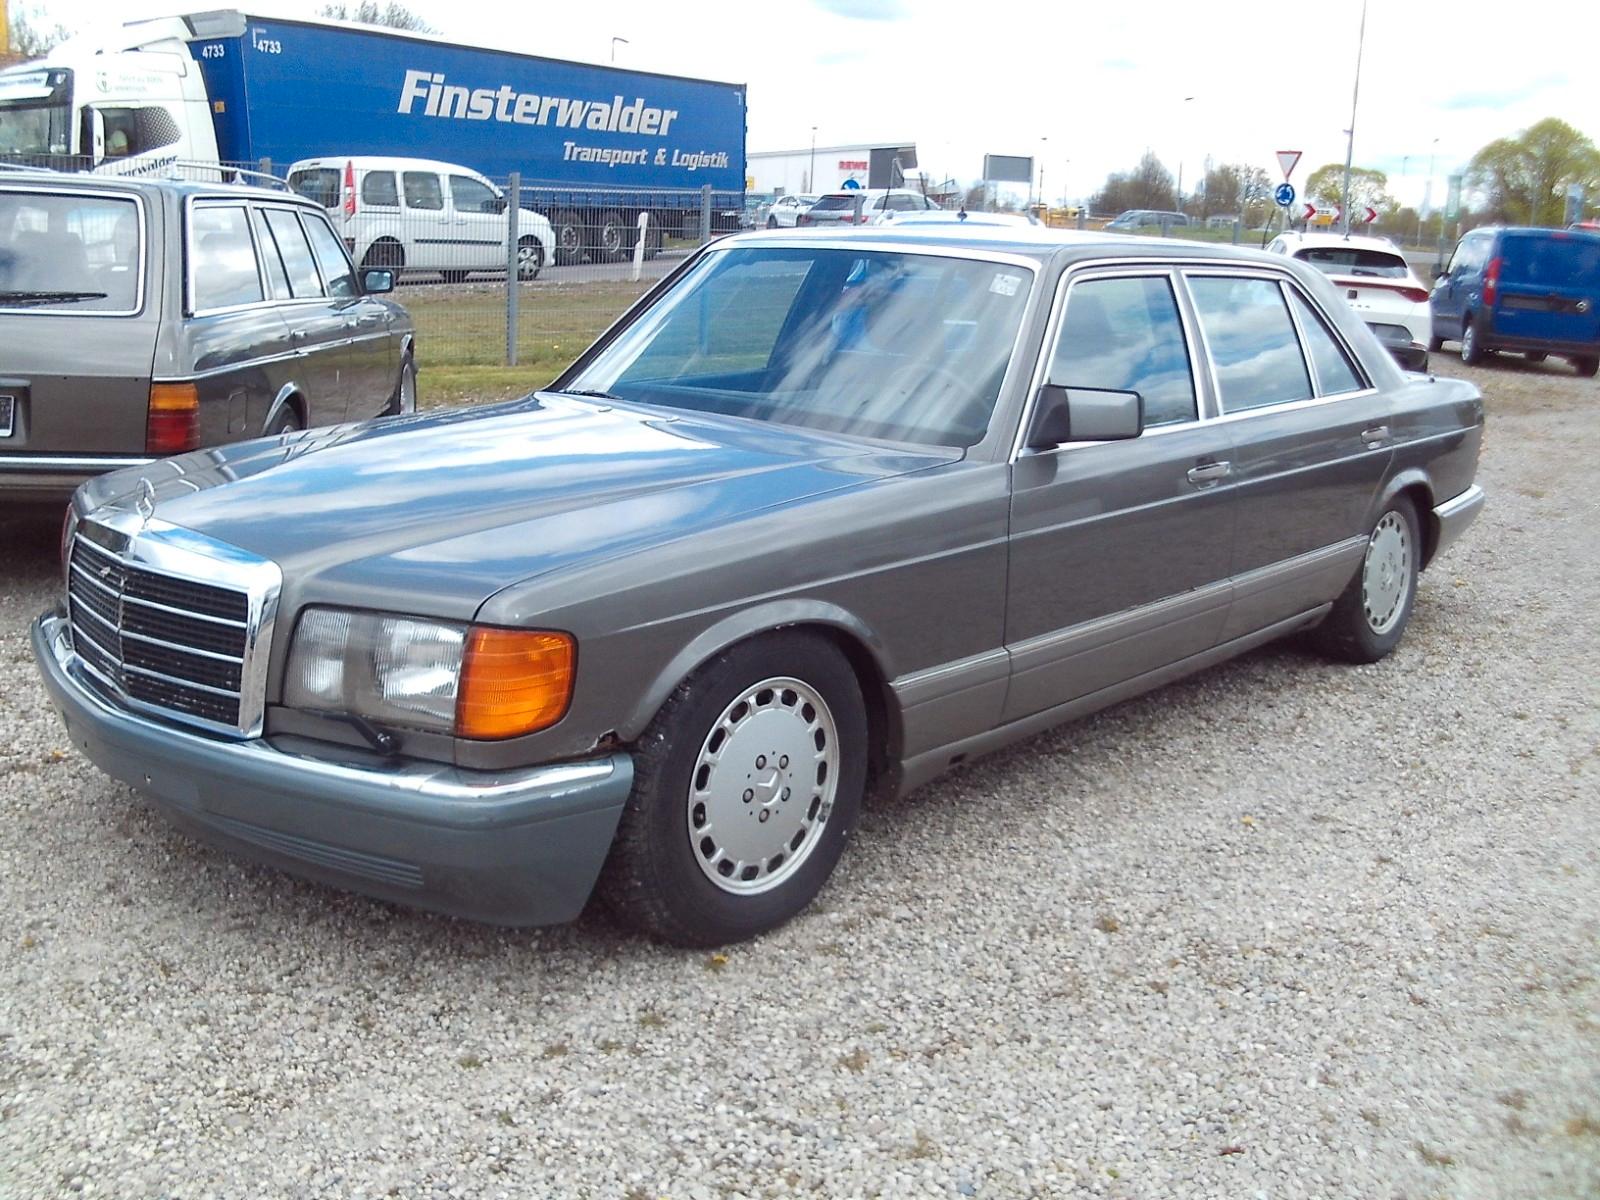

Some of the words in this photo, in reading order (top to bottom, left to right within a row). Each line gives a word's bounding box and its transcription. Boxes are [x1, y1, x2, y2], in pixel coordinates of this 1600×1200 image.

[202, 44, 224, 58] 4733
[257, 40, 282, 54] 4733
[397, 69, 678, 136] Finsterwalder
[563, 141, 648, 167] Transport
[653, 148, 666, 166] &
[671, 149, 729, 171] Logistik
[839, 160, 868, 171] REWE
